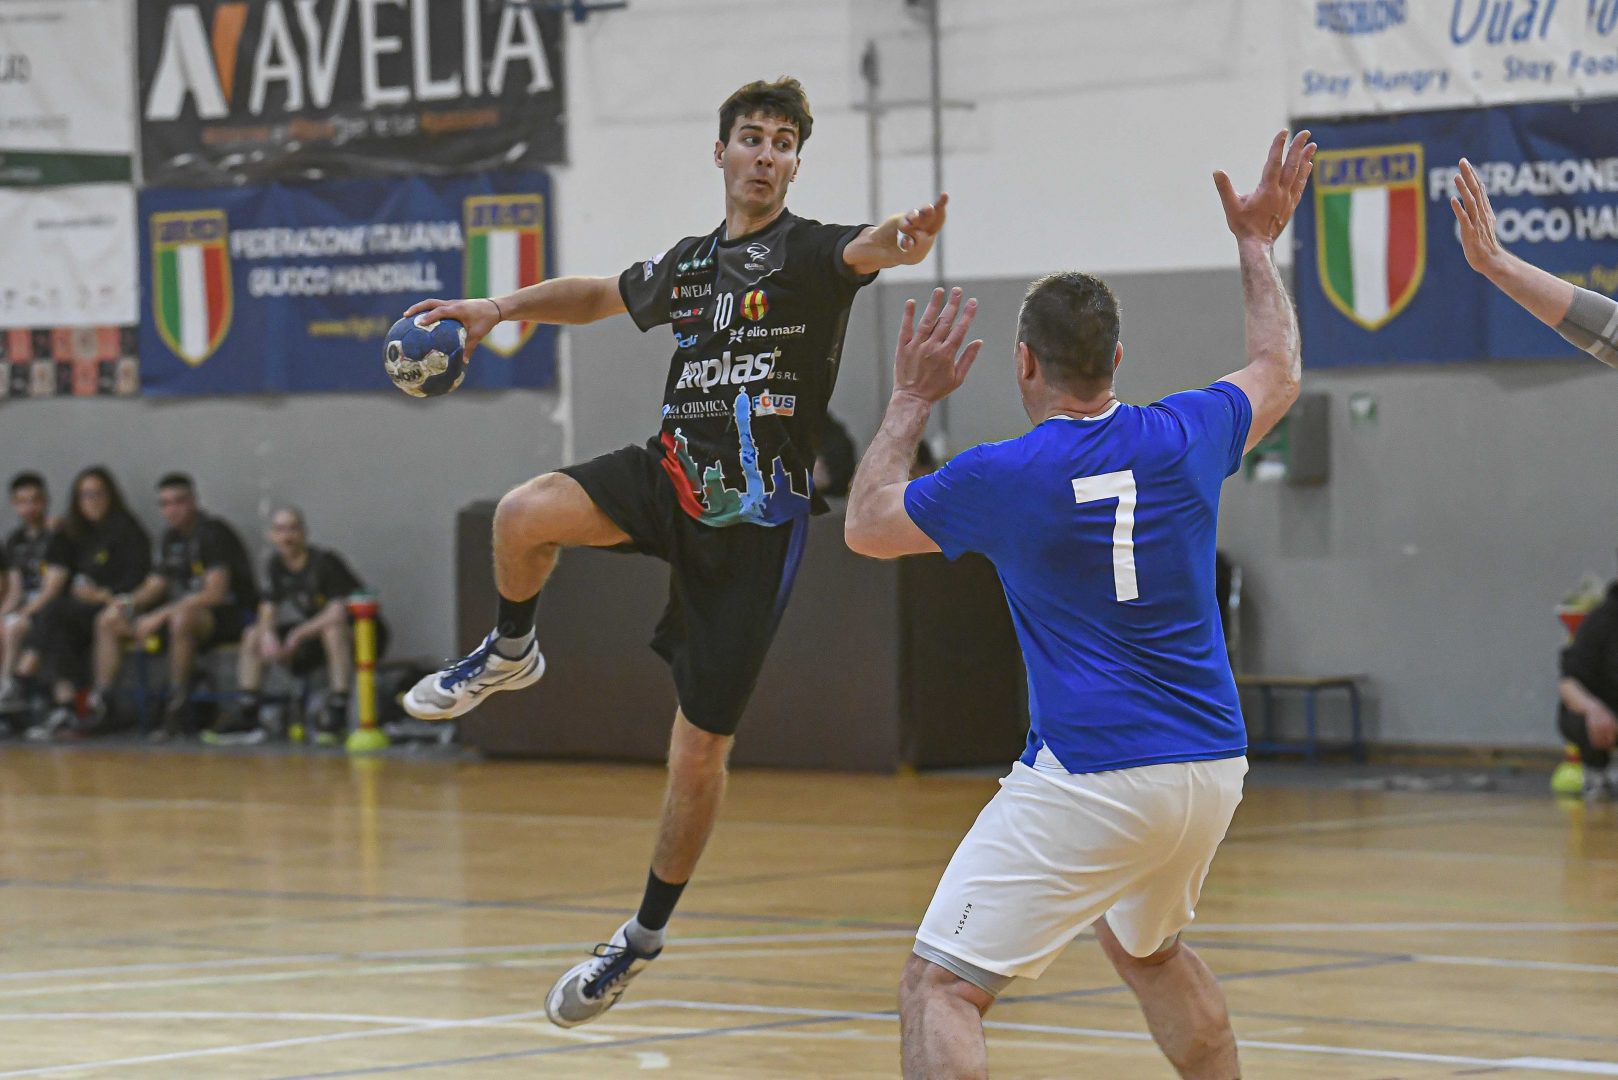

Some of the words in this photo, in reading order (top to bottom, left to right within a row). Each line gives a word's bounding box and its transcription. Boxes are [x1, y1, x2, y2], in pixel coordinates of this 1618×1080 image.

[248, 0, 553, 115] AVELIA
[680, 283, 712, 298] AVELIA
[713, 293, 734, 332] 10
[746, 326, 768, 337] elio
[770, 324, 806, 336] mazzi
[682, 400, 729, 414] CHIMICA
[1071, 469, 1138, 602] 7
[954, 903, 973, 935] KIPSTA
